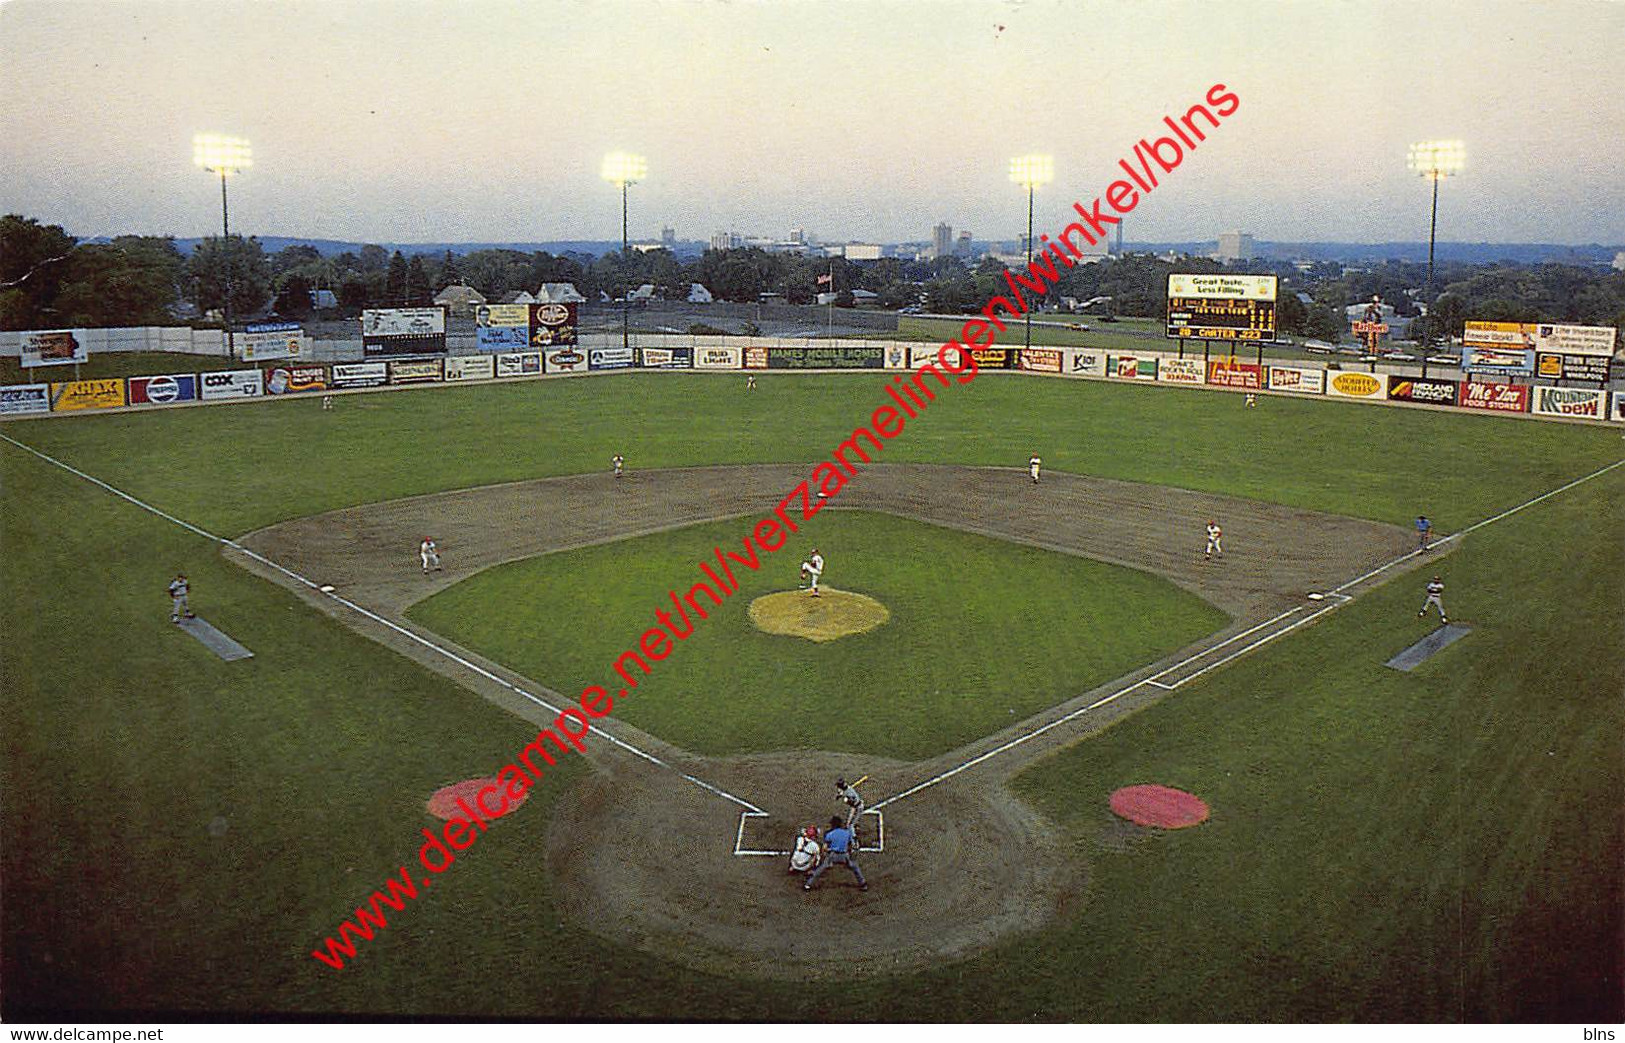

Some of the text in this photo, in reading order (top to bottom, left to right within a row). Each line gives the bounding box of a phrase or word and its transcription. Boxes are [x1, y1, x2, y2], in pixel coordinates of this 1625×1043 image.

[1198, 286, 1245, 295] Less Filling
[1198, 329, 1236, 339] CARTER
[807, 349, 844, 358] MOBILE
[703, 357, 732, 365] LIGHT
[205, 374, 233, 386] COX
[1413, 382, 1454, 393] MIDLAND
[1467, 383, 1492, 400] Me
[1463, 399, 1521, 410] FOOD STORES
